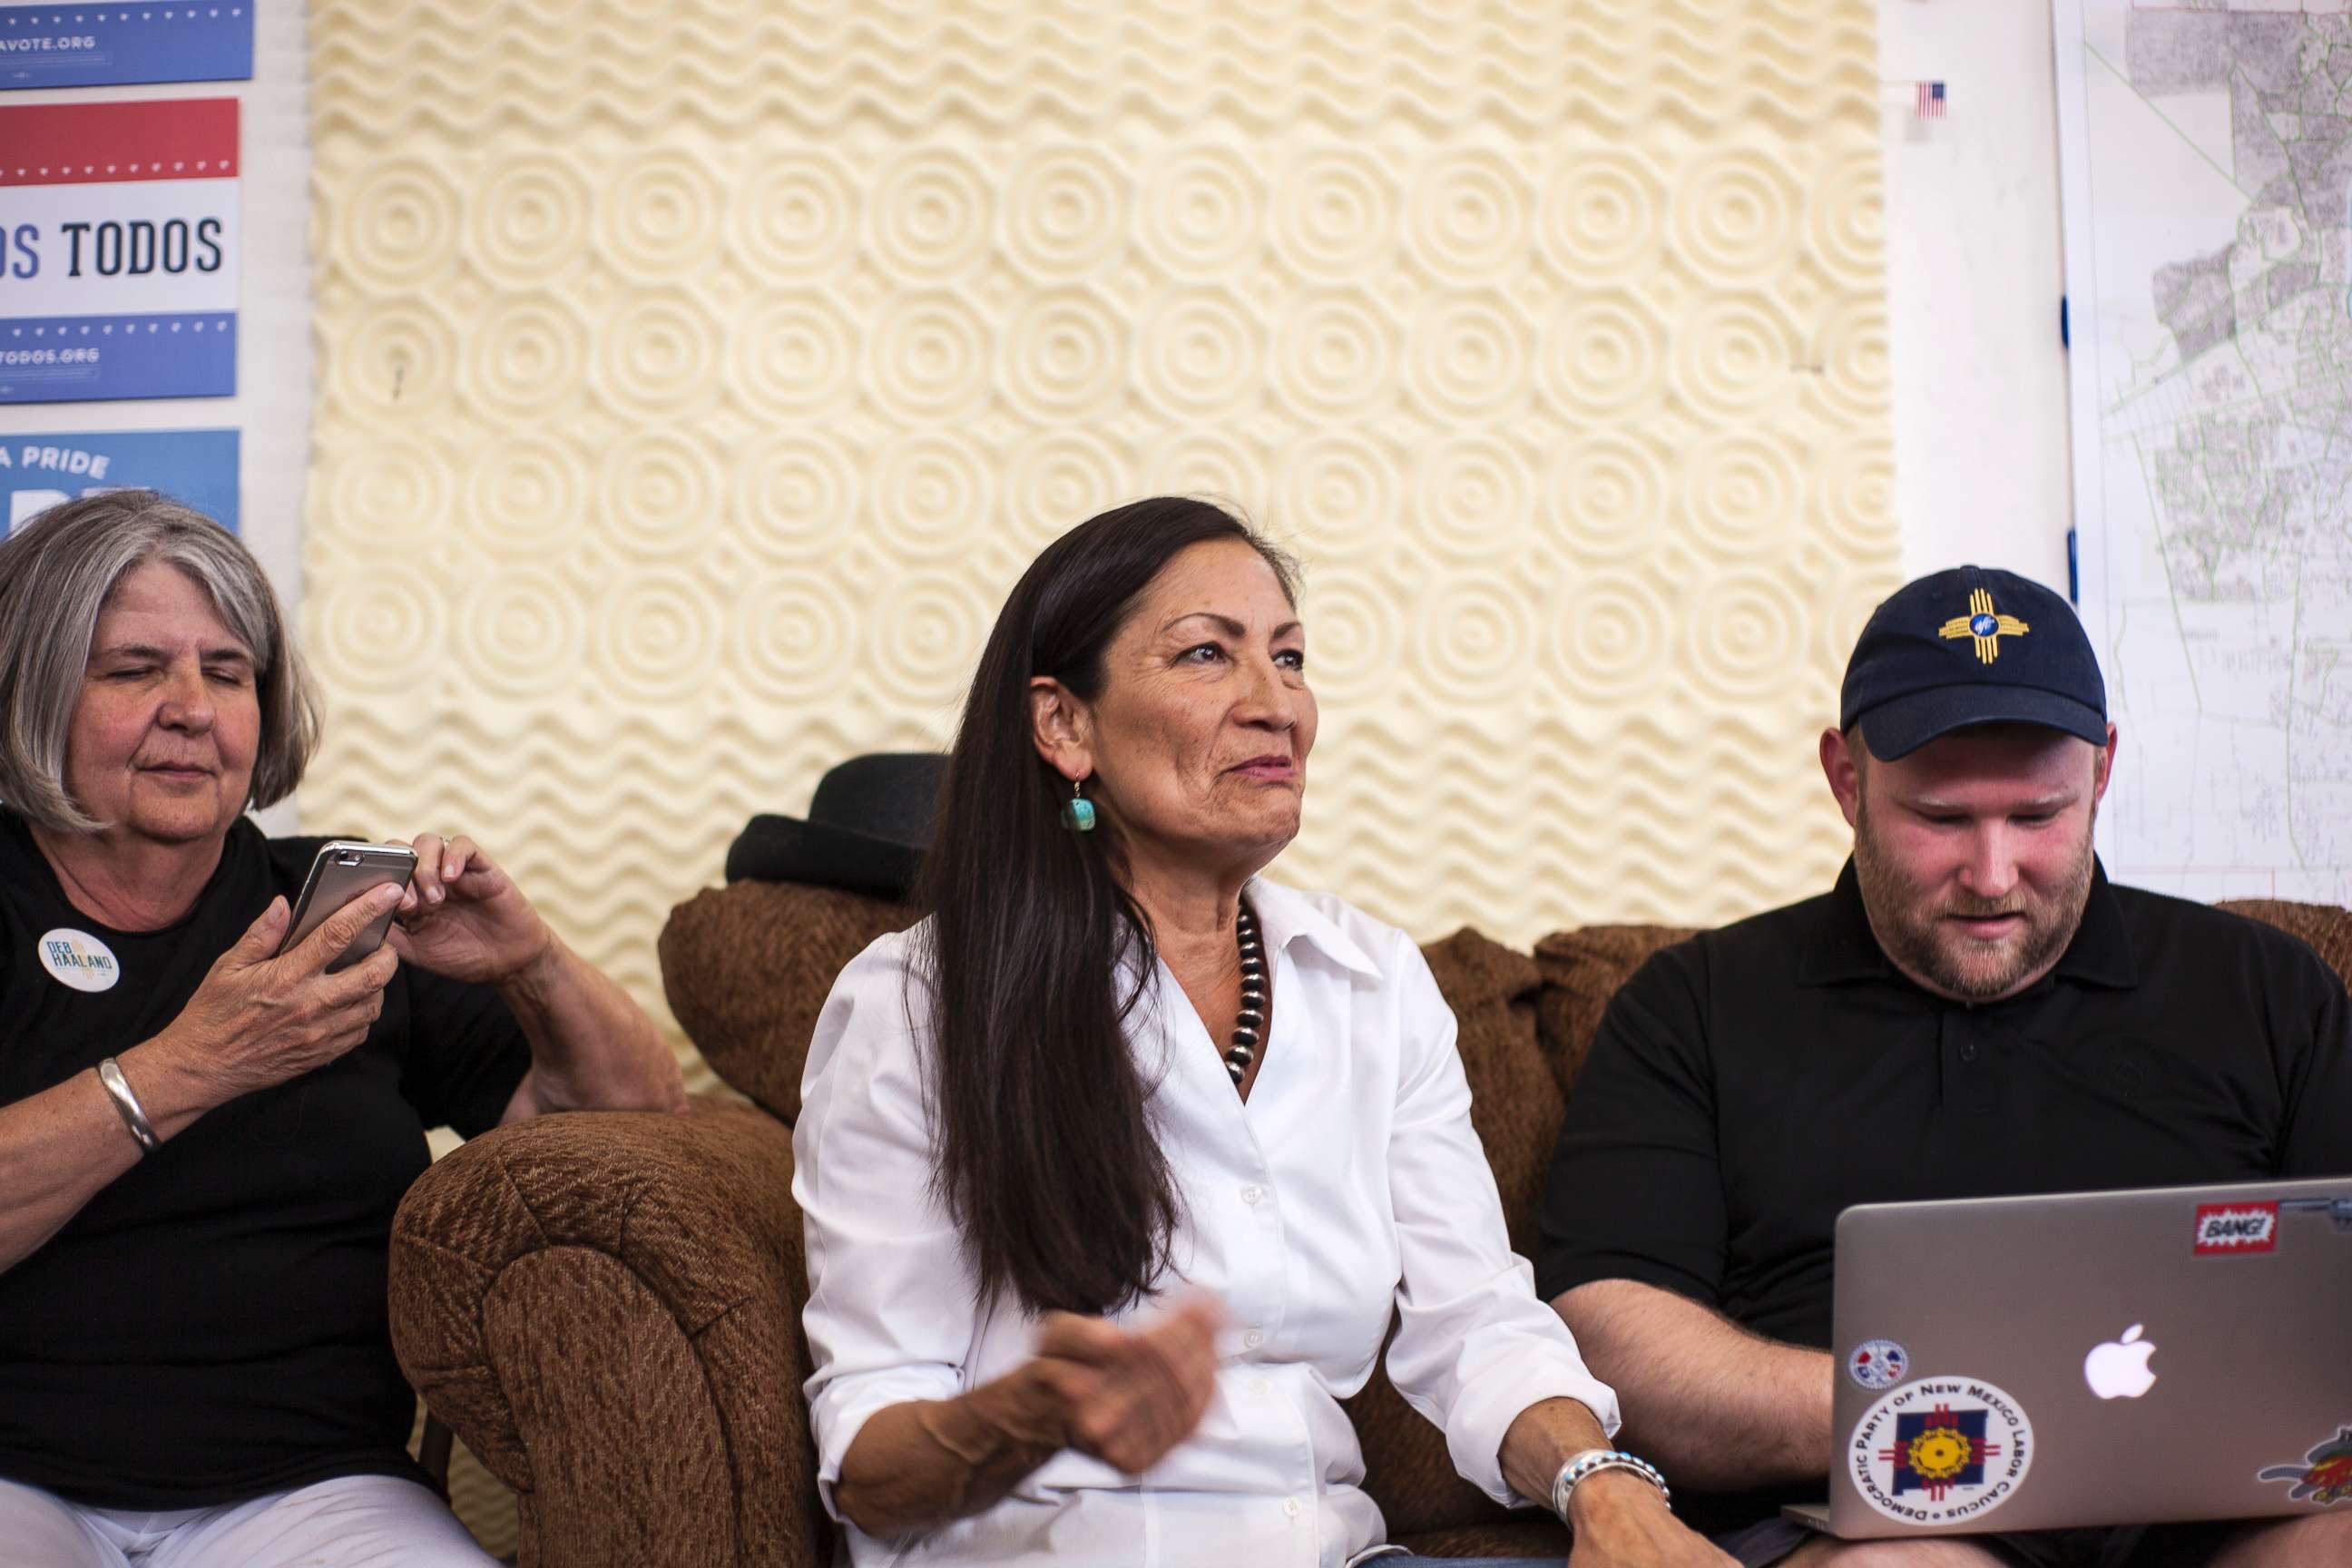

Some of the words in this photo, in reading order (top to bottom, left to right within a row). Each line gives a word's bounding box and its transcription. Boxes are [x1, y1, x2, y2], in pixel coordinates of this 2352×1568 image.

[0, 224, 39, 279] S
[61, 218, 222, 277] TODOS
[22, 446, 111, 480] PRIDE
[46, 941, 73, 954] DEB
[52, 954, 113, 969] HAALAND
[2206, 1218, 2267, 1239] BANG!
